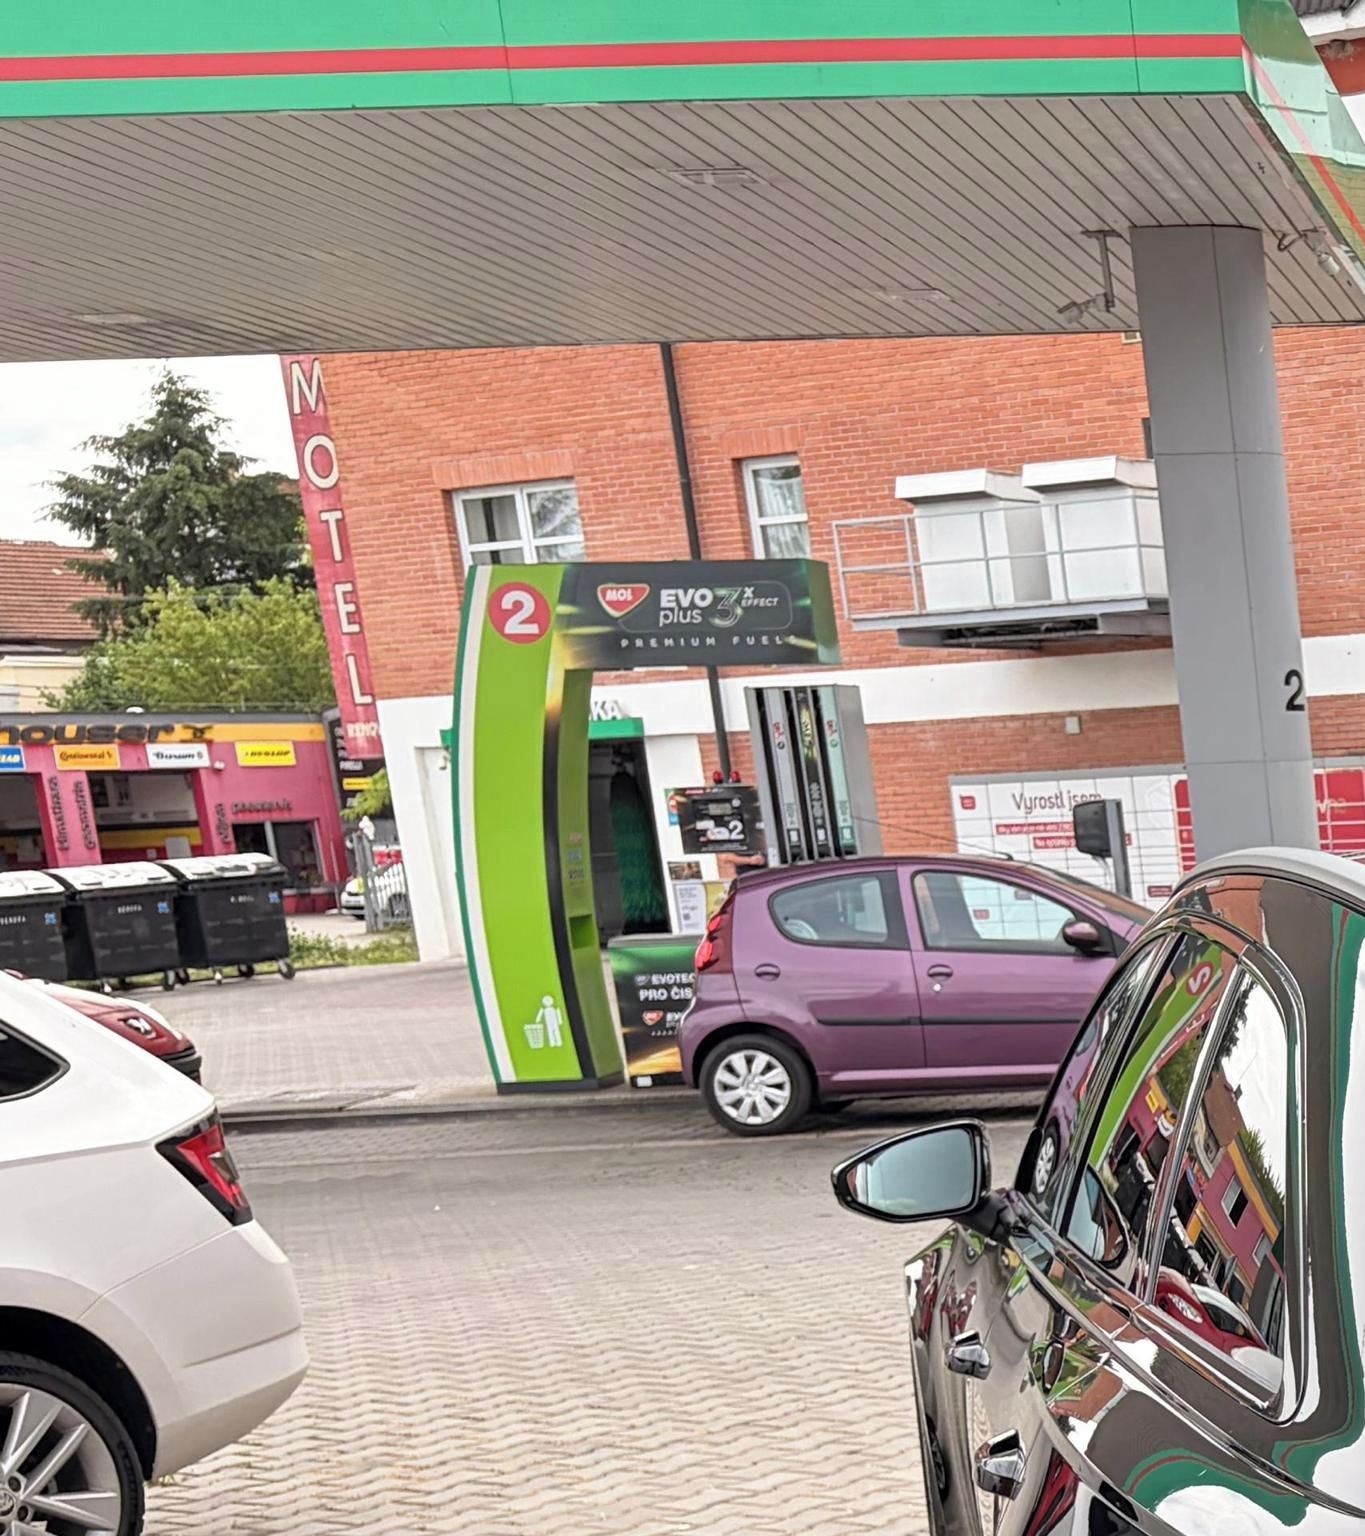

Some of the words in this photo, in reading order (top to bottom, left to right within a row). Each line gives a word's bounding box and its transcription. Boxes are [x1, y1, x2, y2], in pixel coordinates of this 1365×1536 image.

[289, 357, 374, 706] MOTEL
[605, 589, 633, 602] MOL
[659, 588, 714, 608] EVO
[740, 597, 779, 608] EFFECT
[500, 590, 540, 635] 2
[658, 606, 703, 627] plus
[620, 636, 717, 649] PREMIUM
[1284, 669, 1306, 711] 2
[591, 700, 621, 721] KA
[1012, 790, 1065, 815] Vyrostl
[728, 819, 745, 840] 2
[639, 988, 667, 1001] PRO
